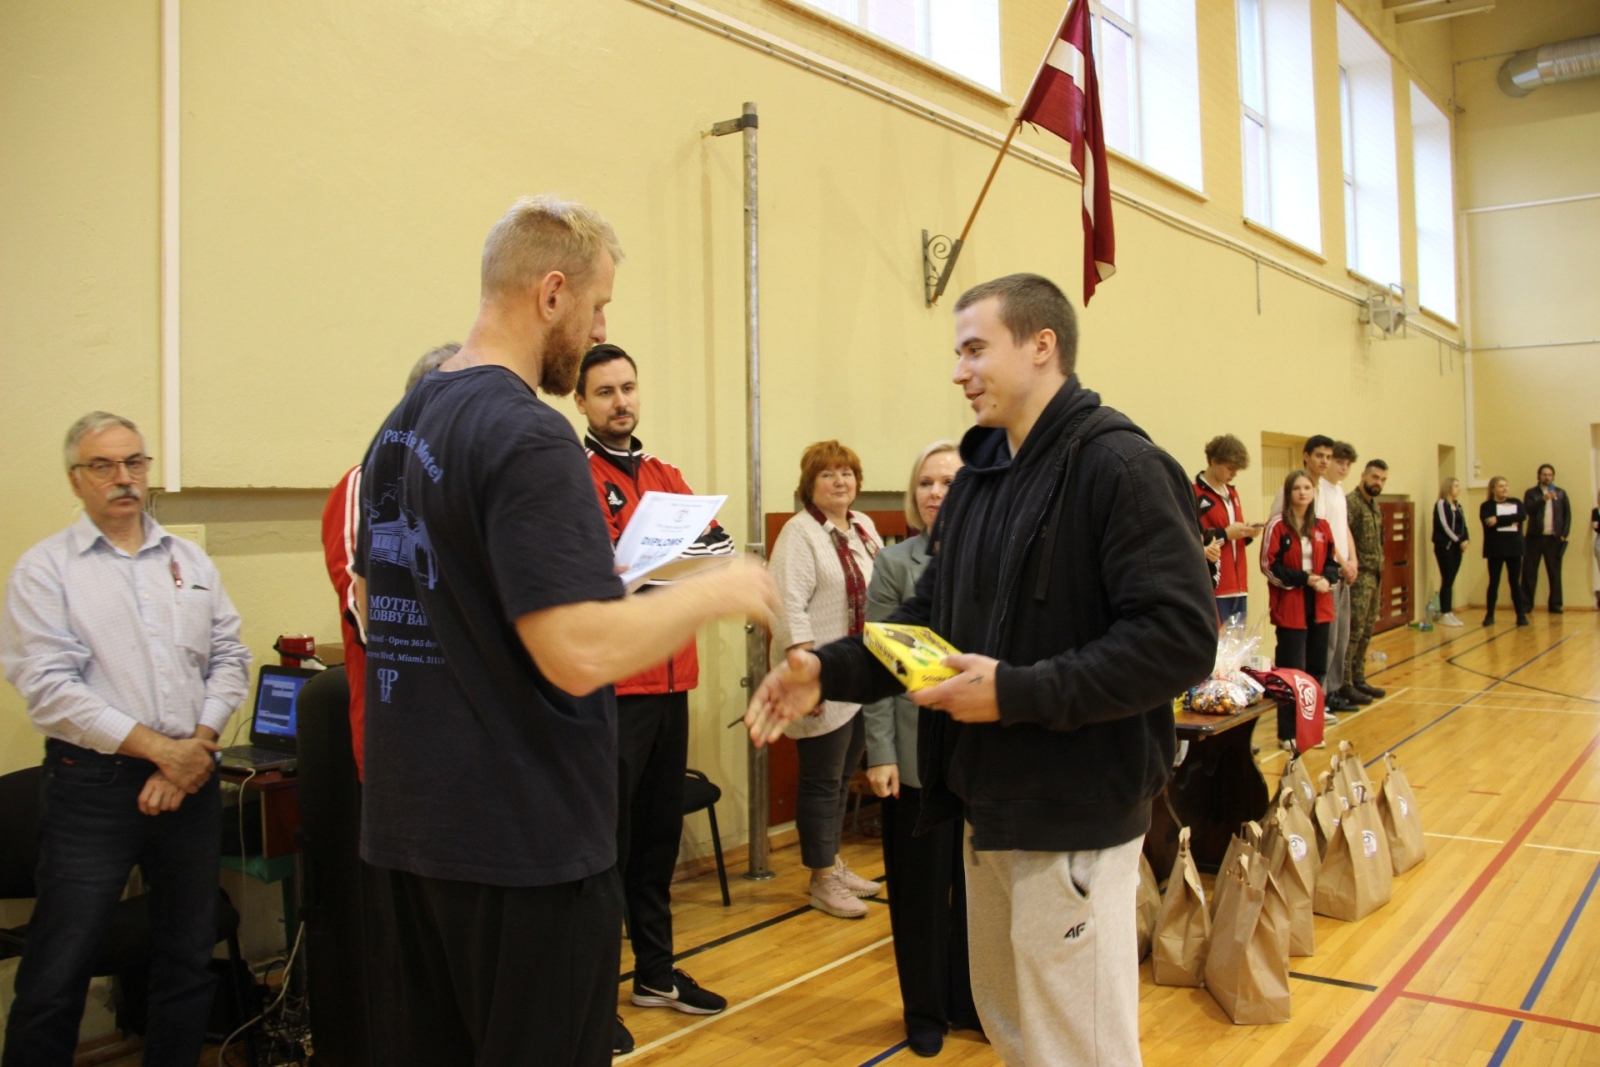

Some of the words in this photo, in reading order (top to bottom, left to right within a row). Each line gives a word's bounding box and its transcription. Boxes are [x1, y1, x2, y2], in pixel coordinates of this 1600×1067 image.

[370, 595, 419, 613] MOTEL
[369, 609, 405, 623] LOBBY
[388, 636, 410, 646] Open
[411, 639, 425, 647] 365
[397, 653, 424, 664] Miami,
